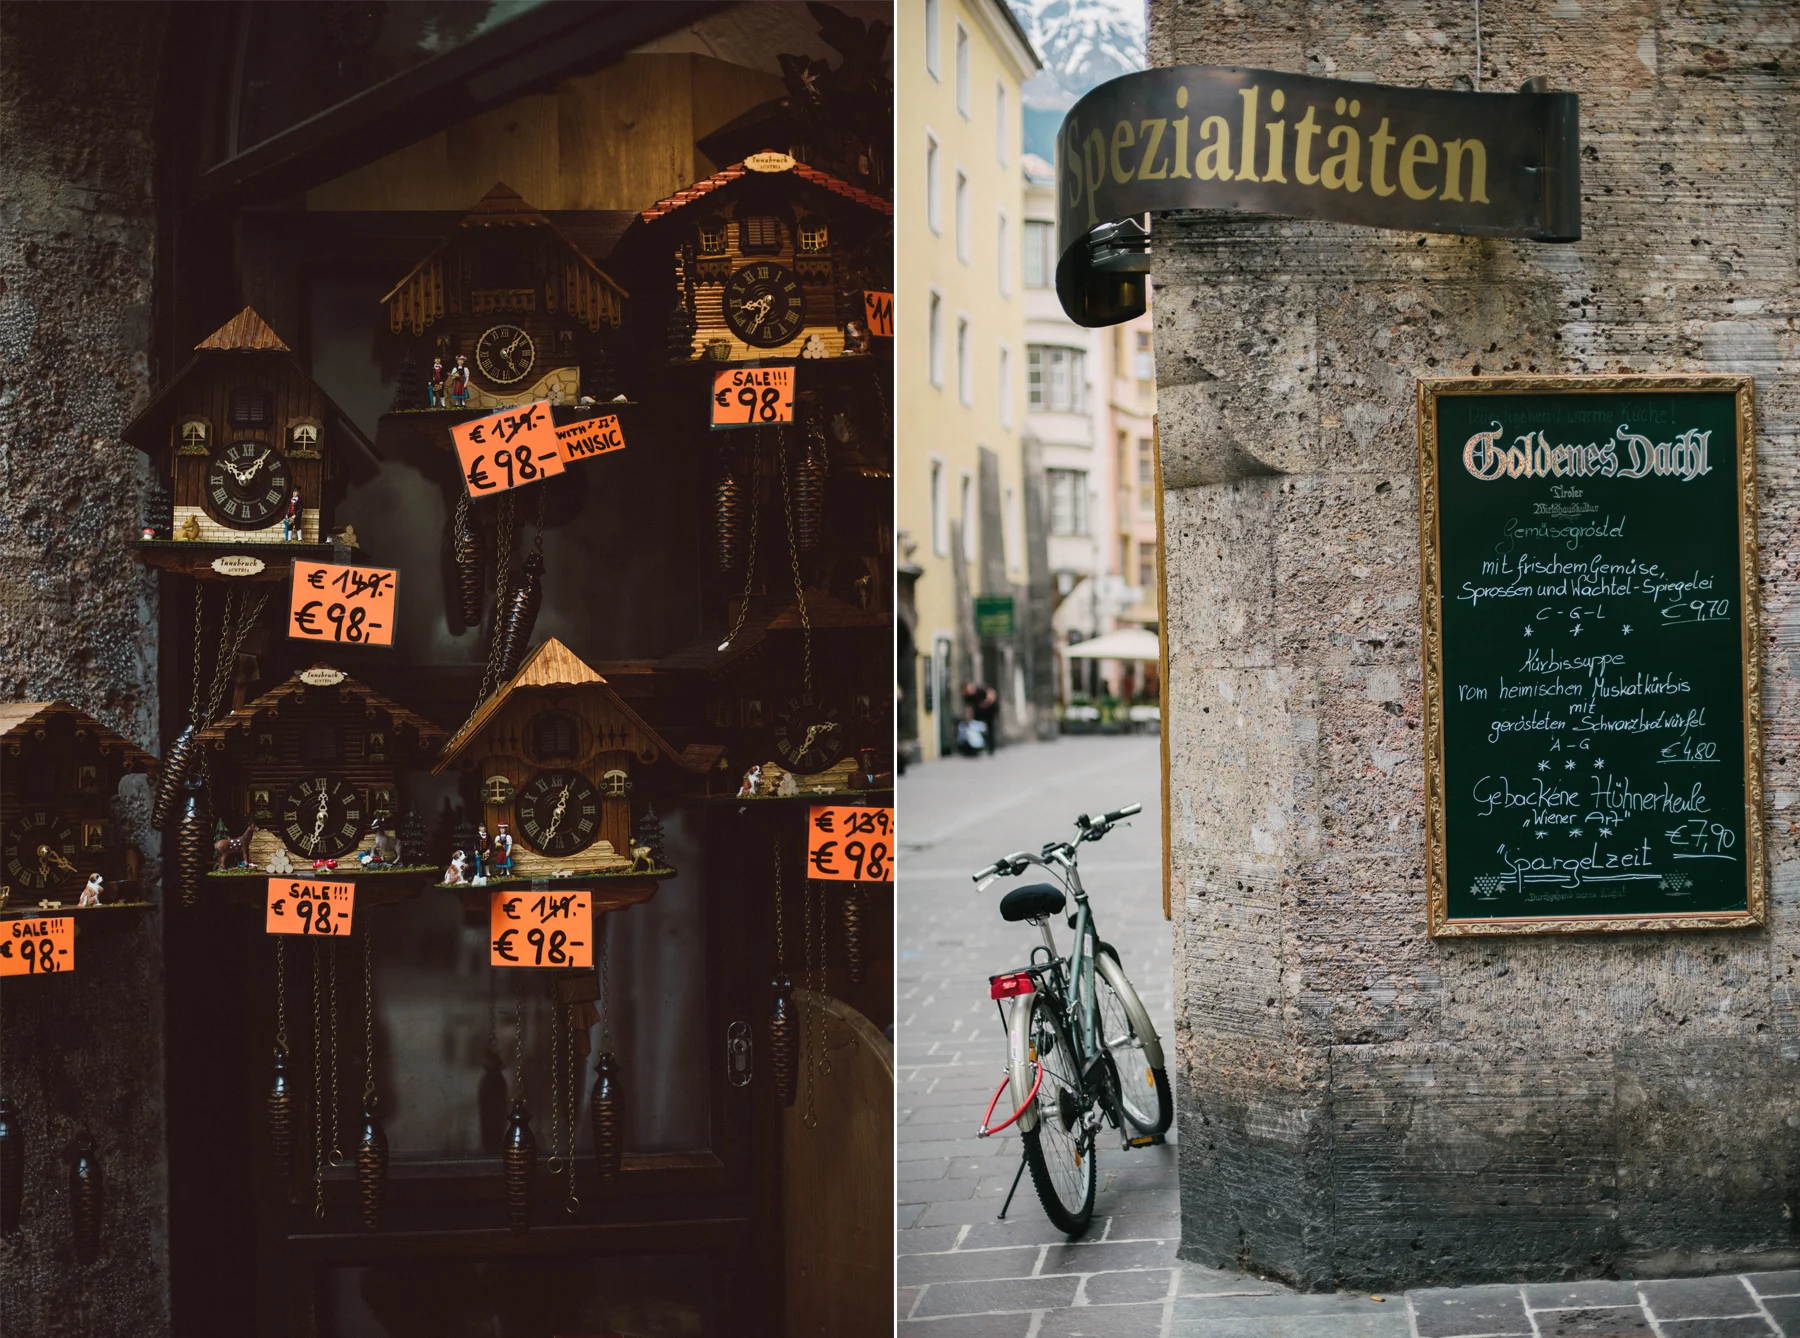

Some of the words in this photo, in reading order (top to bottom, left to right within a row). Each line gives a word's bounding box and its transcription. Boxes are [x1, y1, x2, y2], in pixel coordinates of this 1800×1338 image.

[1067, 85, 1490, 229] Spezialitäten
[872, 296, 894, 335] 11
[733, 371, 788, 387] SALE!!!
[556, 426, 587, 440] WITH
[566, 430, 621, 457] MUSIC
[1463, 421, 1618, 480] Goldenes
[1616, 424, 1713, 481] Dachl
[1550, 485, 1583, 498] Tiroler
[221, 559, 257, 567] Innsbruck
[1481, 555, 1513, 575] mit
[1512, 553, 1588, 584] frischem
[1457, 582, 1533, 606] Sprossen
[1537, 579, 1567, 596] und
[1519, 648, 1626, 677] Kürbissuppe
[1500, 676, 1583, 698] heimischen
[1592, 672, 1690, 698] Muskatkürbis
[1569, 698, 1596, 714] mit
[1488, 709, 1566, 743] gerösteten
[1473, 776, 1581, 817] Gebackene
[1590, 774, 1711, 813] Hühnerkeule
[289, 883, 348, 900] SALE!!!
[12, 919, 64, 938] SALE!!!
